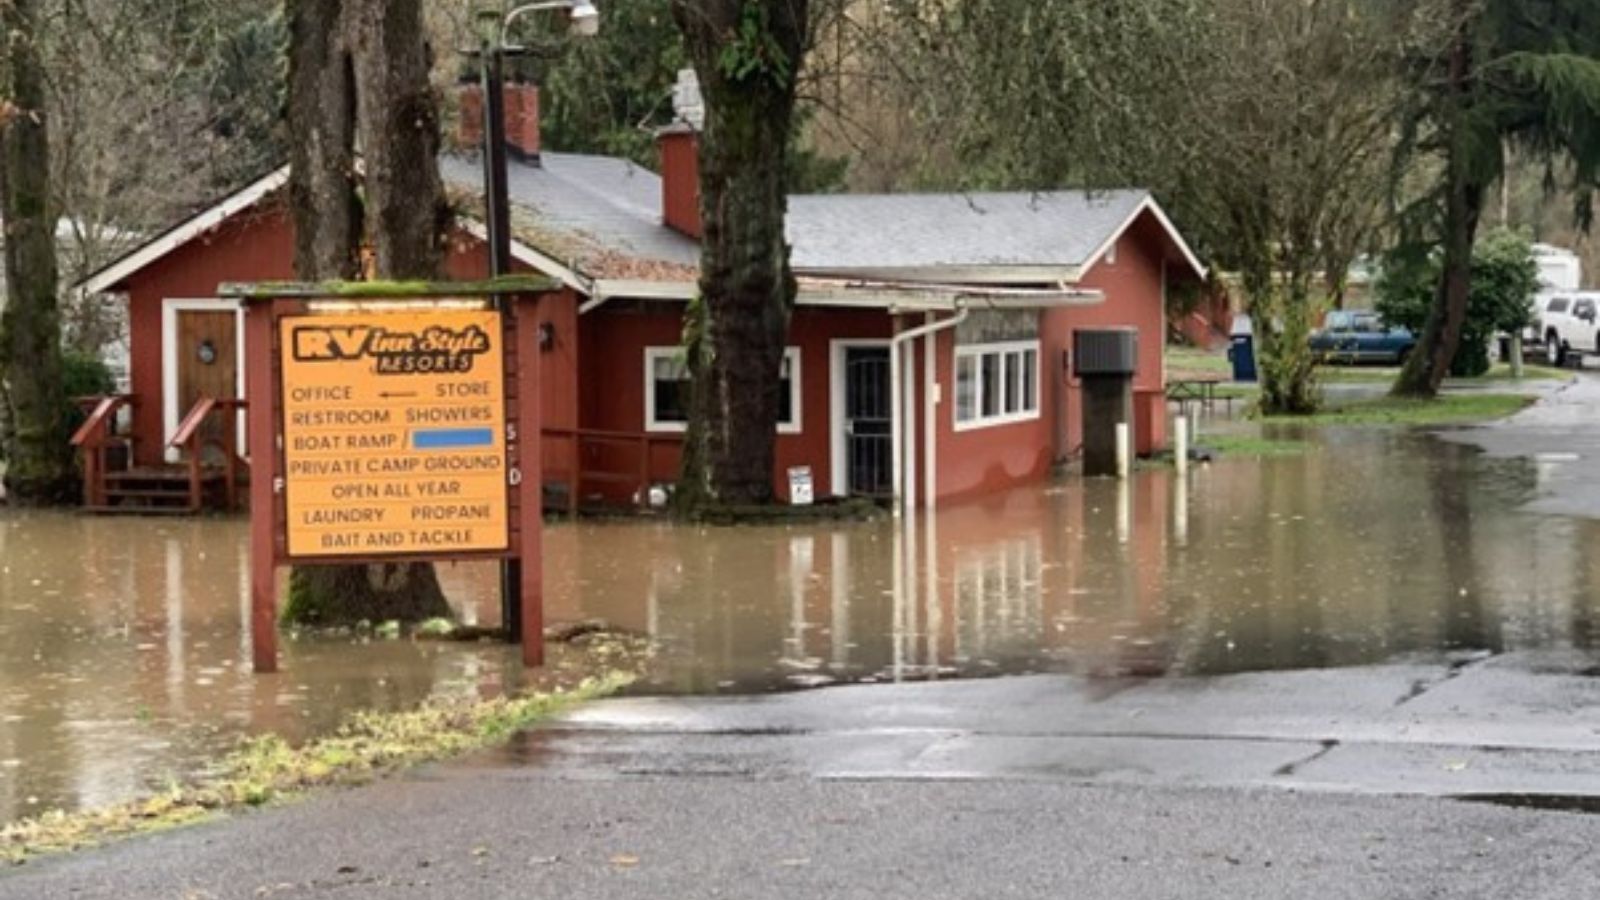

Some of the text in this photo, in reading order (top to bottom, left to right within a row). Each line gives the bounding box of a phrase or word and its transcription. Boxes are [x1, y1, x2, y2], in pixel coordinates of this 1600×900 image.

[295, 328, 369, 358] RV
[379, 354, 469, 371] RESORTS
[292, 383, 490, 402] OFFICE STORE
[292, 407, 492, 425] RESTROOM SHOWERS
[294, 435, 341, 450] BOAT
[346, 433, 397, 448] RAMP
[290, 455, 501, 475] PRIVATE CAMP GROUND
[332, 481, 461, 498] OPEN ALL YEAR
[303, 505, 491, 524] LAUNDRY PROPANE
[321, 530, 473, 548] BAIT AND TACKLE
